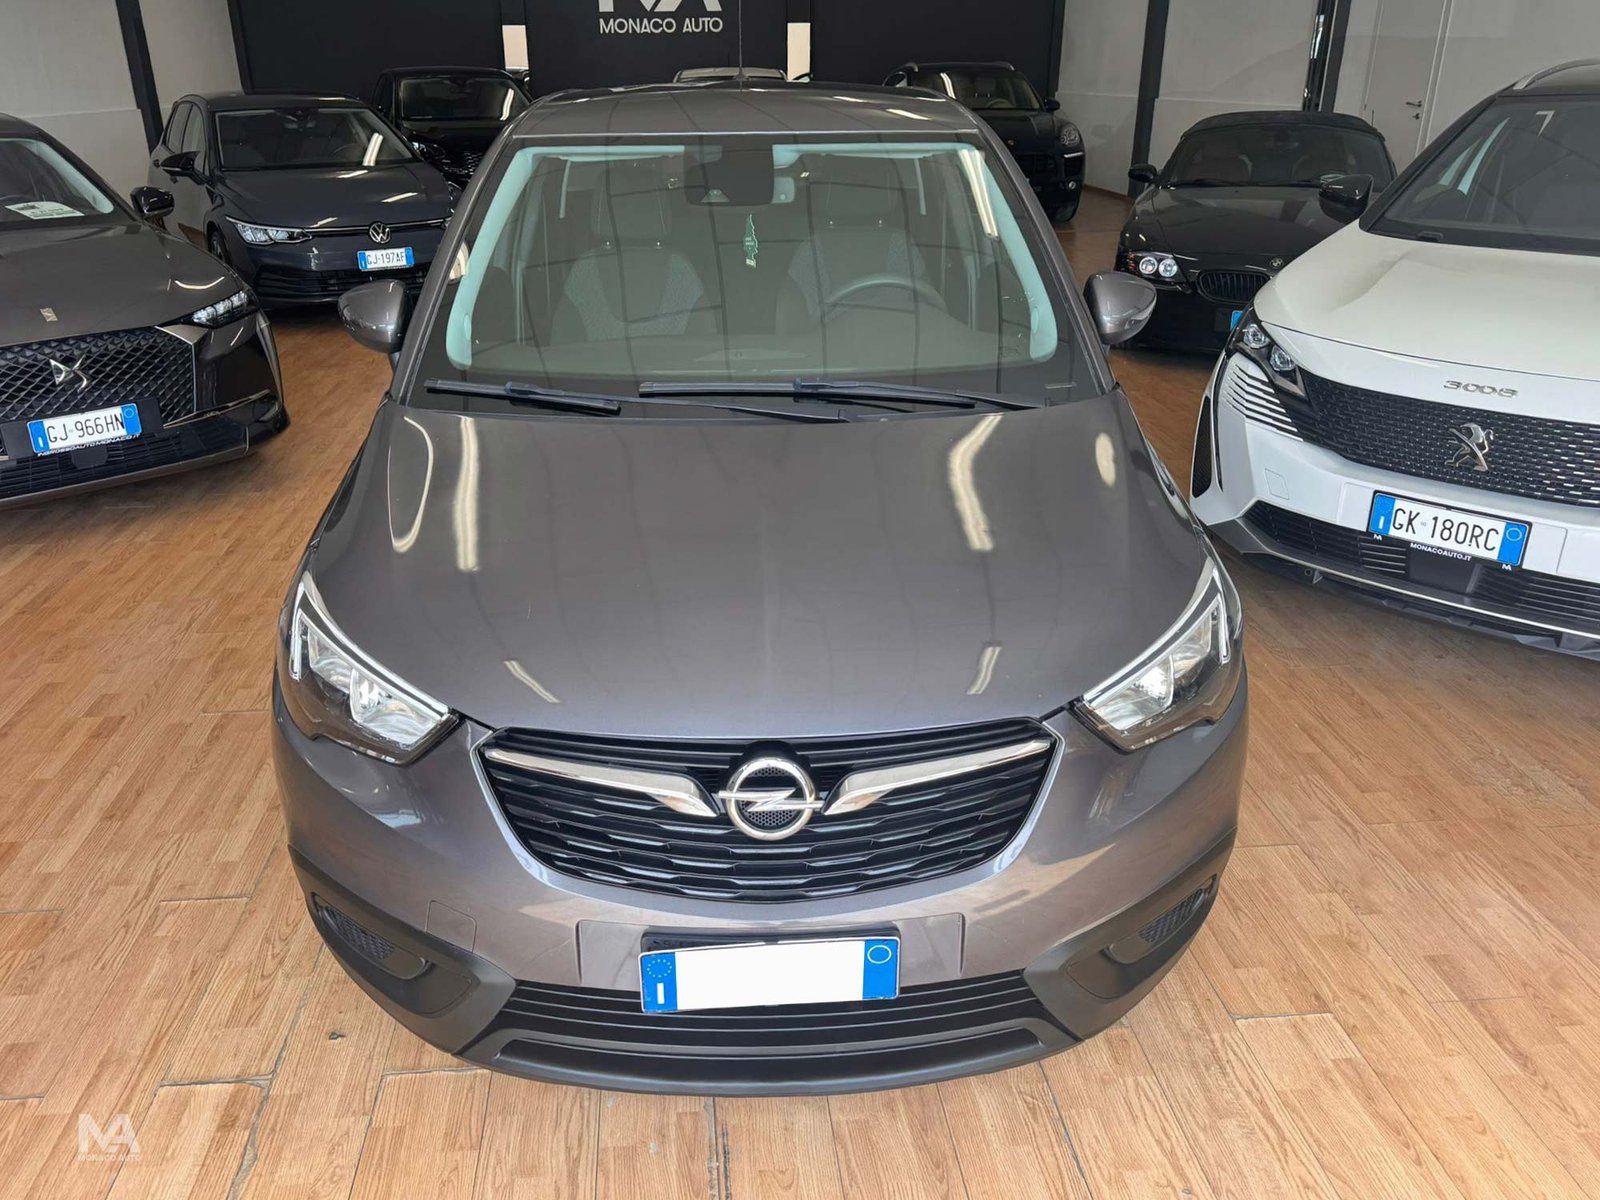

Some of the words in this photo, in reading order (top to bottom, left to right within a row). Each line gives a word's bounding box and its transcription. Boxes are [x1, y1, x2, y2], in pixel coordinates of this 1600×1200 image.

[599, 18, 676, 34] MONACO
[682, 17, 723, 33] AUTO
[1443, 380, 1518, 398] 3008
[1410, 542, 1472, 562] MONACOAUTO.IT
